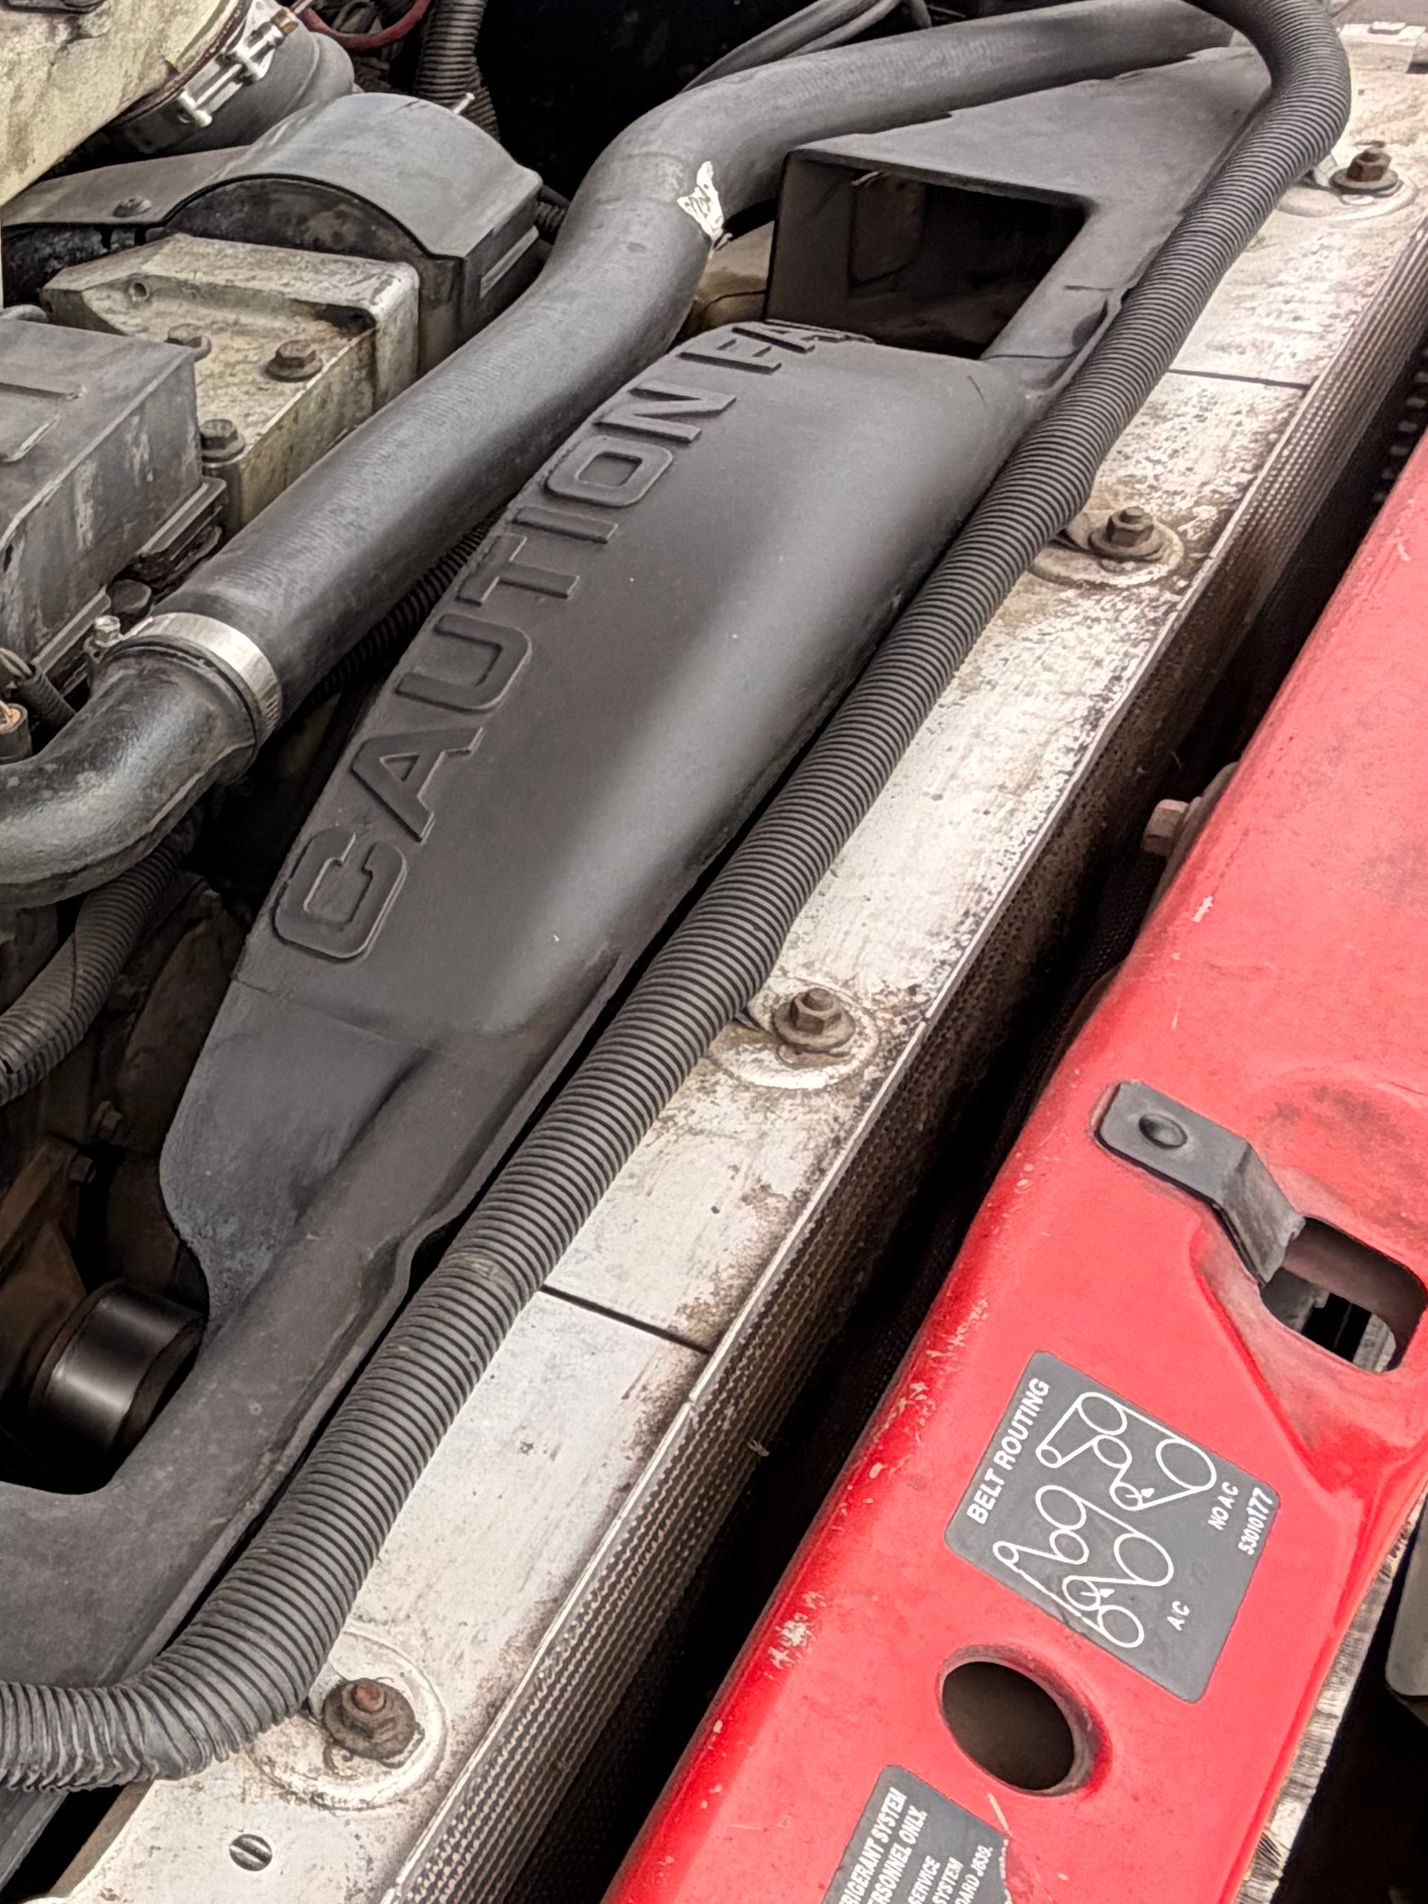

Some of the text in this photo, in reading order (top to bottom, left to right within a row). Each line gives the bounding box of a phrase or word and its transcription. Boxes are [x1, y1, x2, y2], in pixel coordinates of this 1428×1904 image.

[273, 384, 738, 963] CAUTION
[966, 1378, 1050, 1524] BELT ROUTING
[1208, 1506, 1229, 1530] NO
[1238, 1487, 1273, 1555] 53010177
[871, 1787, 907, 1844] SYSTEM
[898, 1805, 928, 1845] ONLY.
